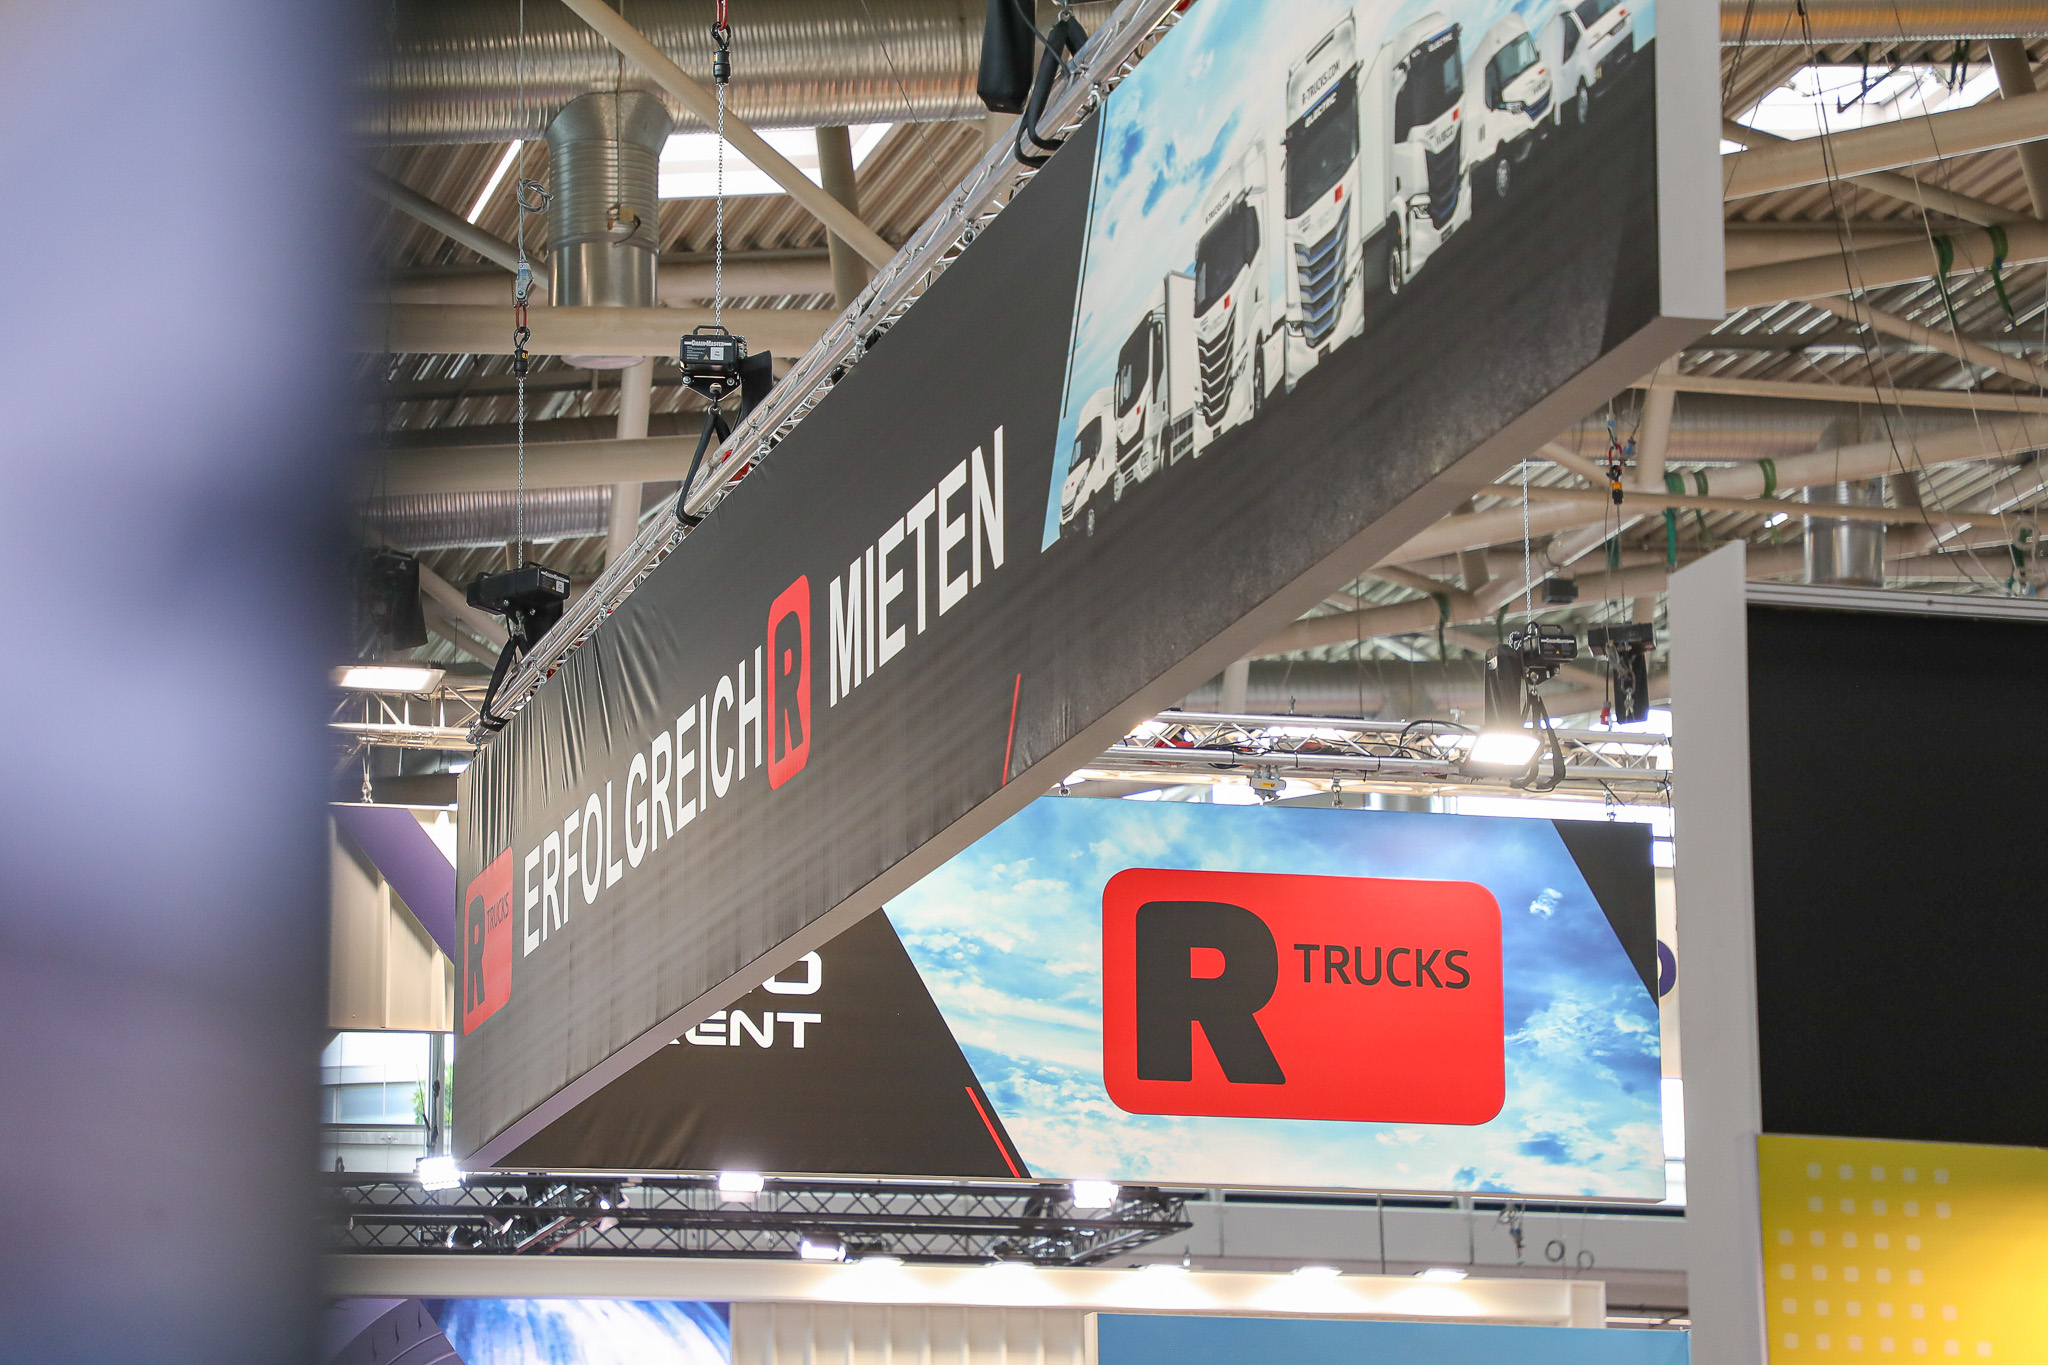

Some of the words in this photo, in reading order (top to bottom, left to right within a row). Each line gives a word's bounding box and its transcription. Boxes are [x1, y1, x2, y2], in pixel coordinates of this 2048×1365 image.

[521, 645, 764, 958] ERFOLGREICH
[774, 610, 807, 771] R
[828, 425, 1005, 708] MIETEN
[467, 894, 486, 1015] R
[486, 892, 509, 934] TRUCKS
[748, 950, 823, 995] O
[1136, 901, 1286, 1085] R
[1294, 943, 1471, 989] TRUCKS
[669, 1009, 822, 1048] ENT
